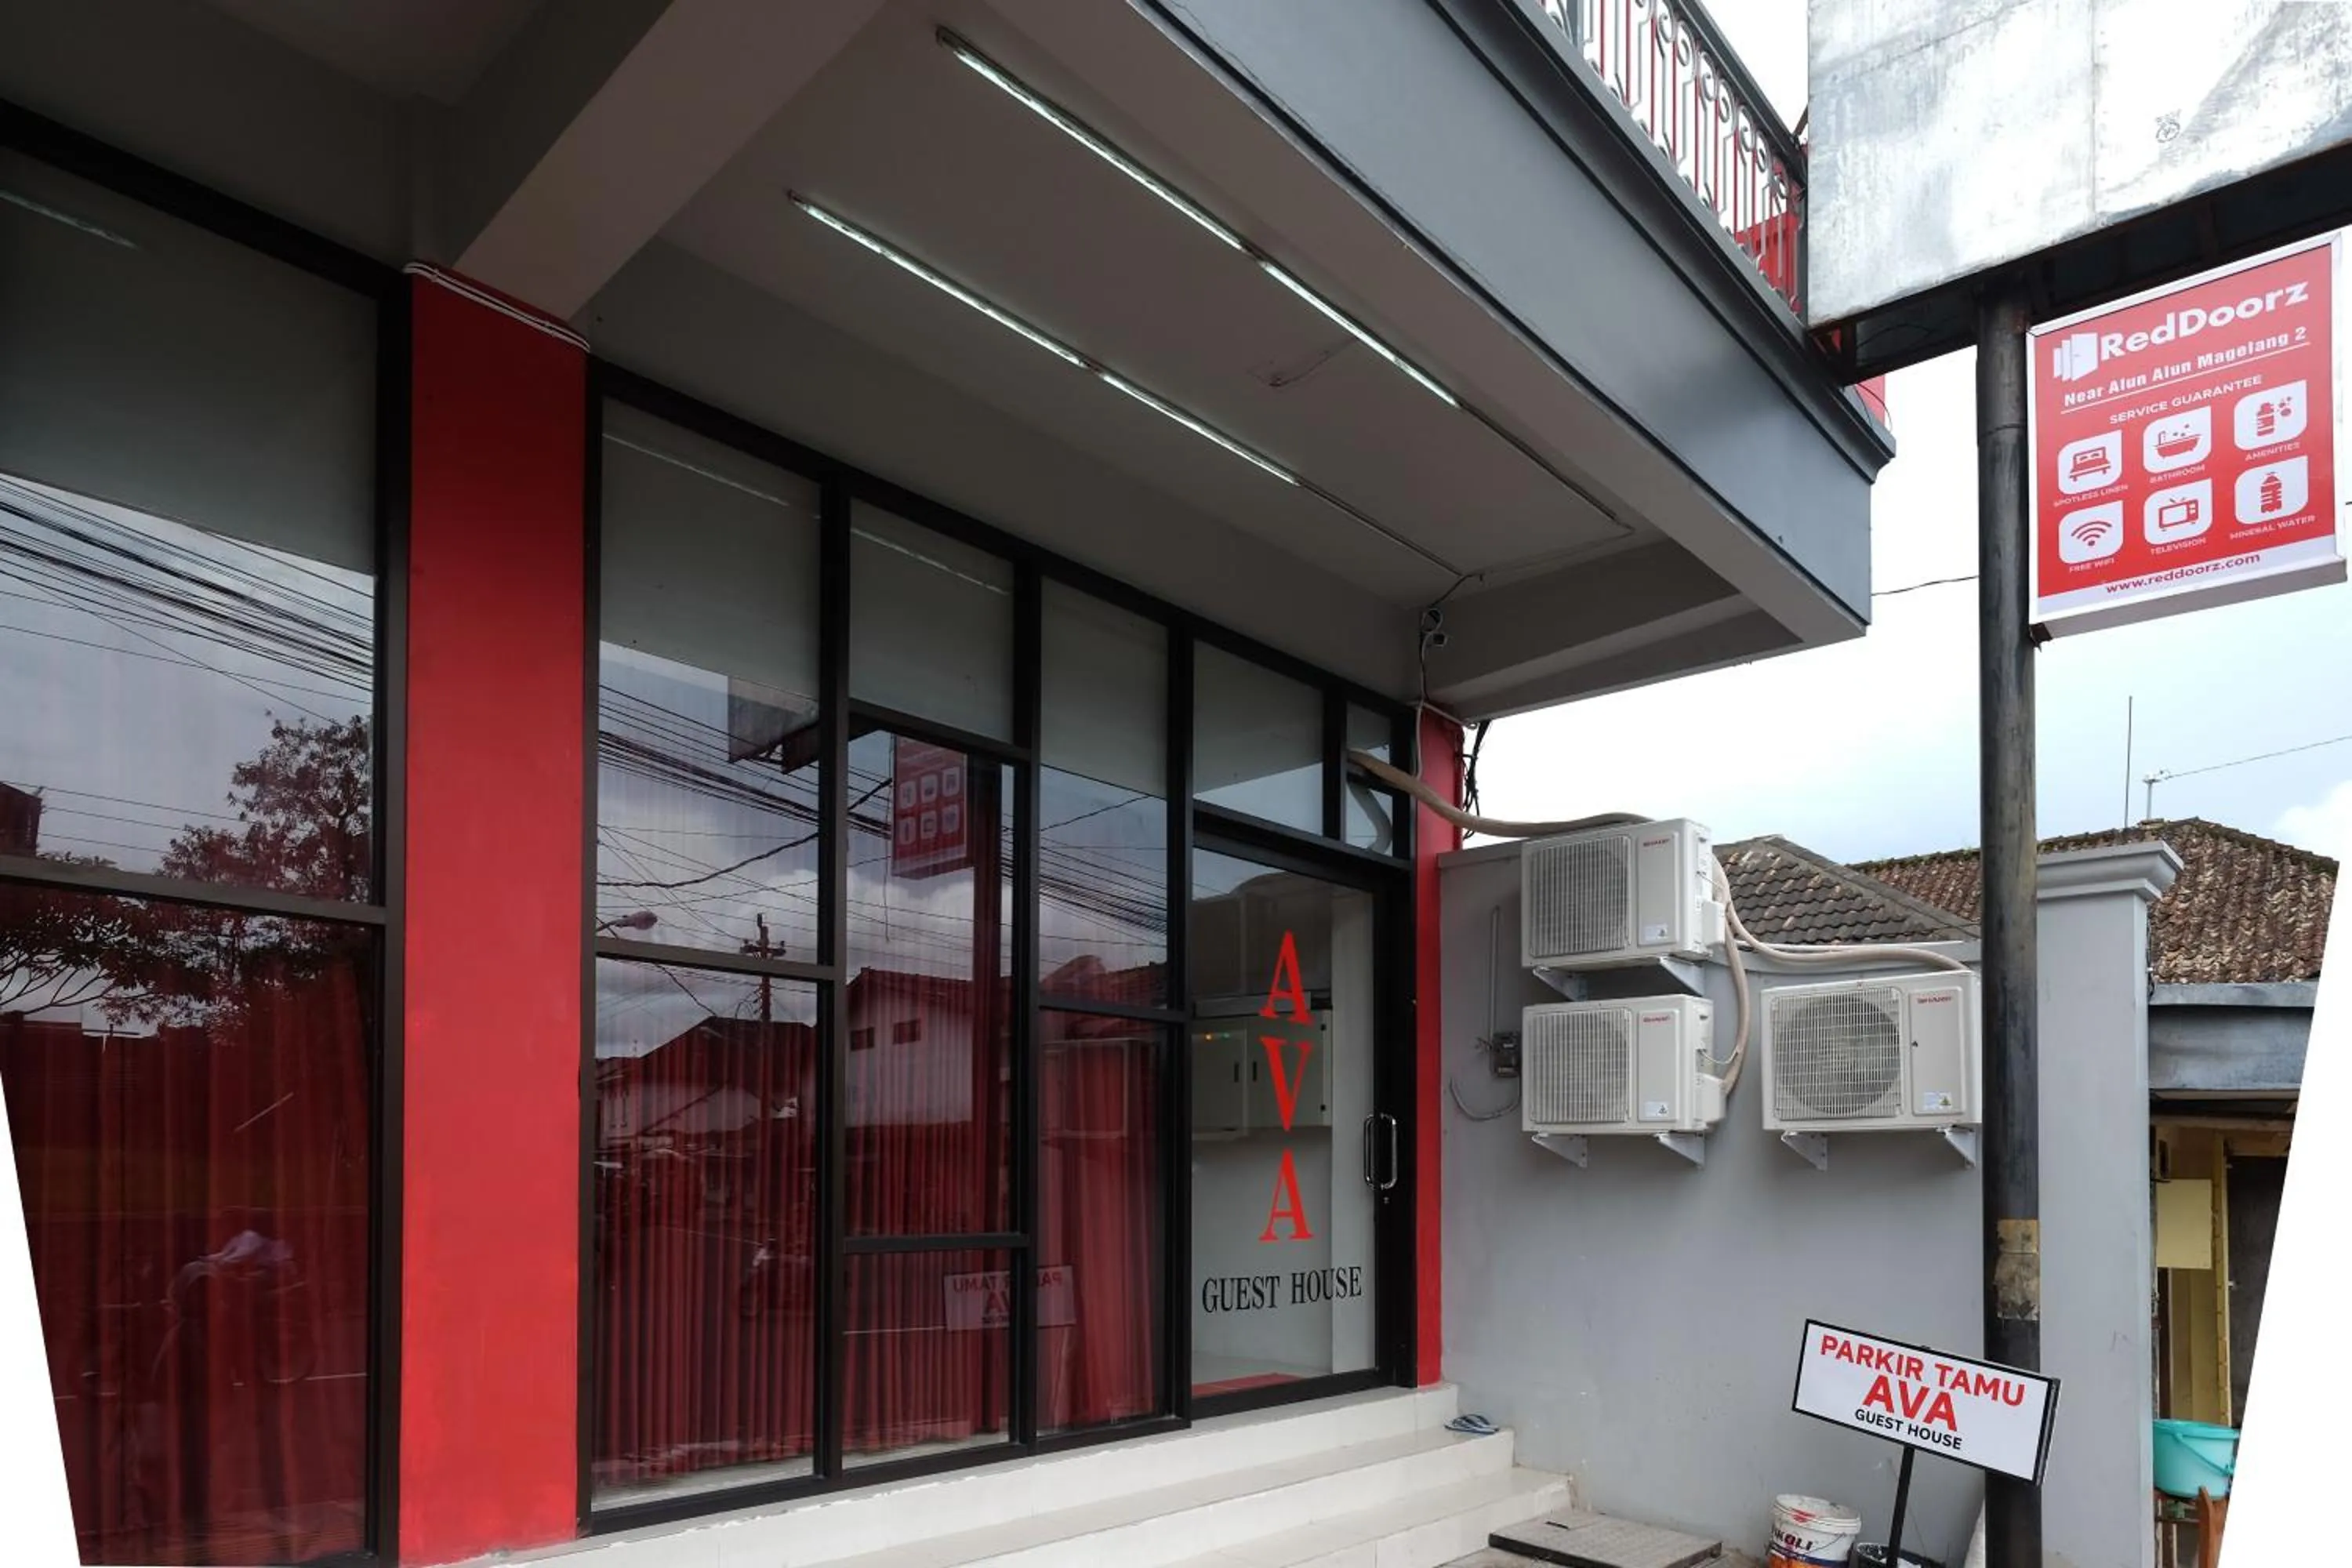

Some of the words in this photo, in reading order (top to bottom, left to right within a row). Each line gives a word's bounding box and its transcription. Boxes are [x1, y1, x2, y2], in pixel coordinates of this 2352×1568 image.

[2100, 281, 2309, 361] RedDoorz
[2064, 387, 2103, 407] Near
[2108, 373, 2147, 394] Alun
[2153, 361, 2191, 382] Alun
[2197, 332, 2288, 369] Magelang
[2295, 326, 2307, 341] 2
[2110, 401, 2168, 424] SERVICE
[2171, 375, 2263, 407] GUARANTEE
[2245, 441, 2300, 461] AMENITIES
[2149, 464, 2205, 484] BATHROOM
[2277, 514, 2316, 530] WATER
[2069, 562, 2092, 573] FREE
[2151, 536, 2207, 555] TELEVISION
[2106, 553, 2261, 594] www.reddoorz.com
[1258, 929, 1314, 1242] AVA
[1201, 1275, 1280, 1314] GUEST
[1291, 1265, 1363, 1305] HOUSE
[1820, 1334, 1925, 1381] PARKIR
[1934, 1362, 2026, 1407] TAMU
[1862, 1374, 1958, 1432] AVA
[1855, 1408, 1904, 1433] GUEST
[1907, 1423, 1963, 1450] HOUSE
